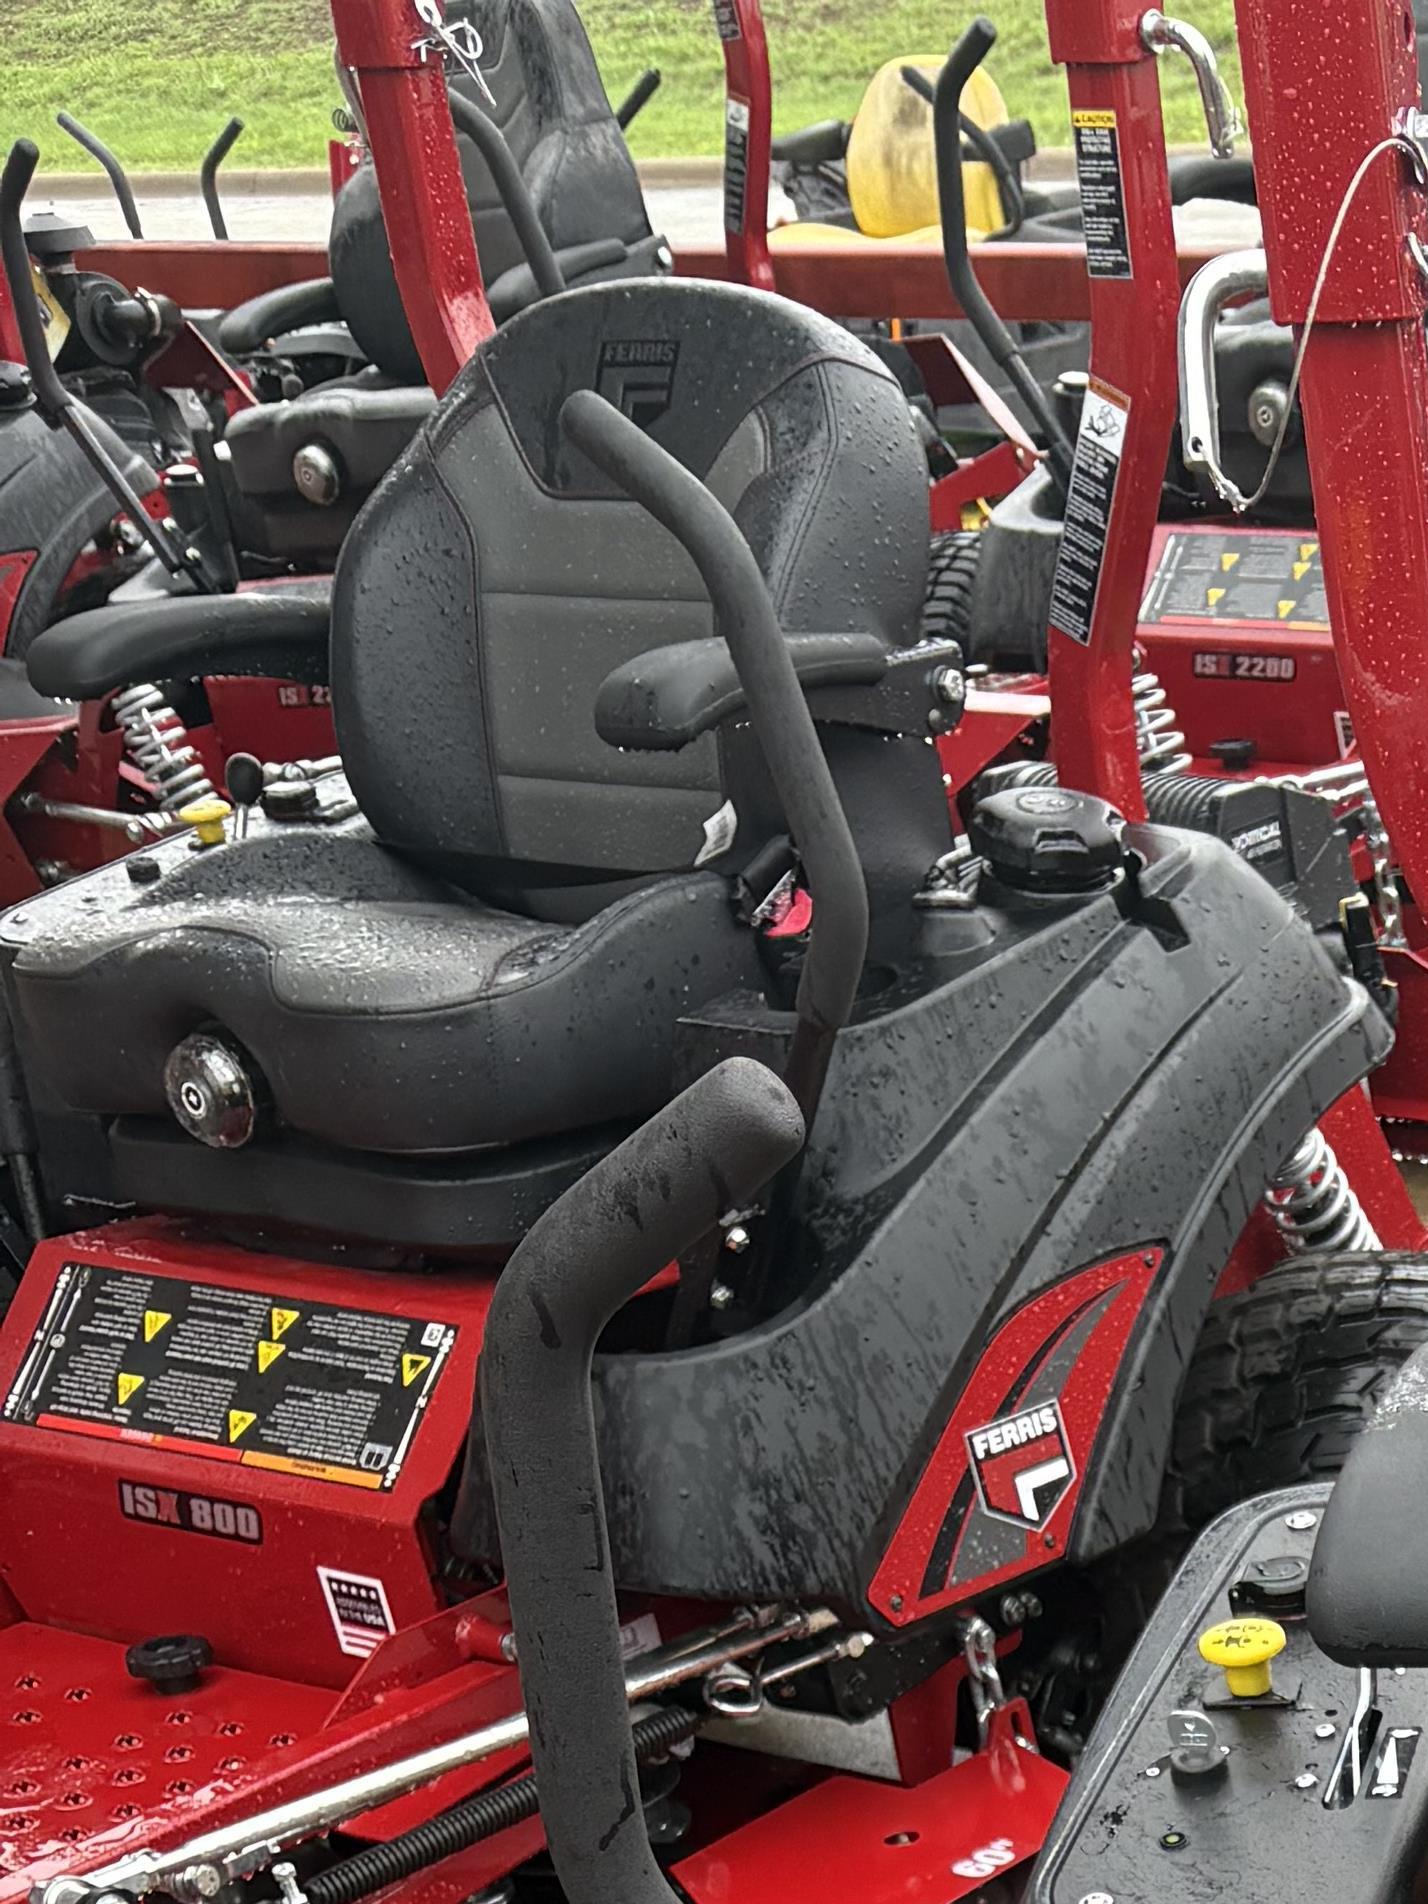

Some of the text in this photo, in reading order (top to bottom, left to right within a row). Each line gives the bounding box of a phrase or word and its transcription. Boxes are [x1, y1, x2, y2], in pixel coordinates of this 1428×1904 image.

[972, 1406, 1057, 1460] FERRIS
[121, 1483, 260, 1539] ISX 800
